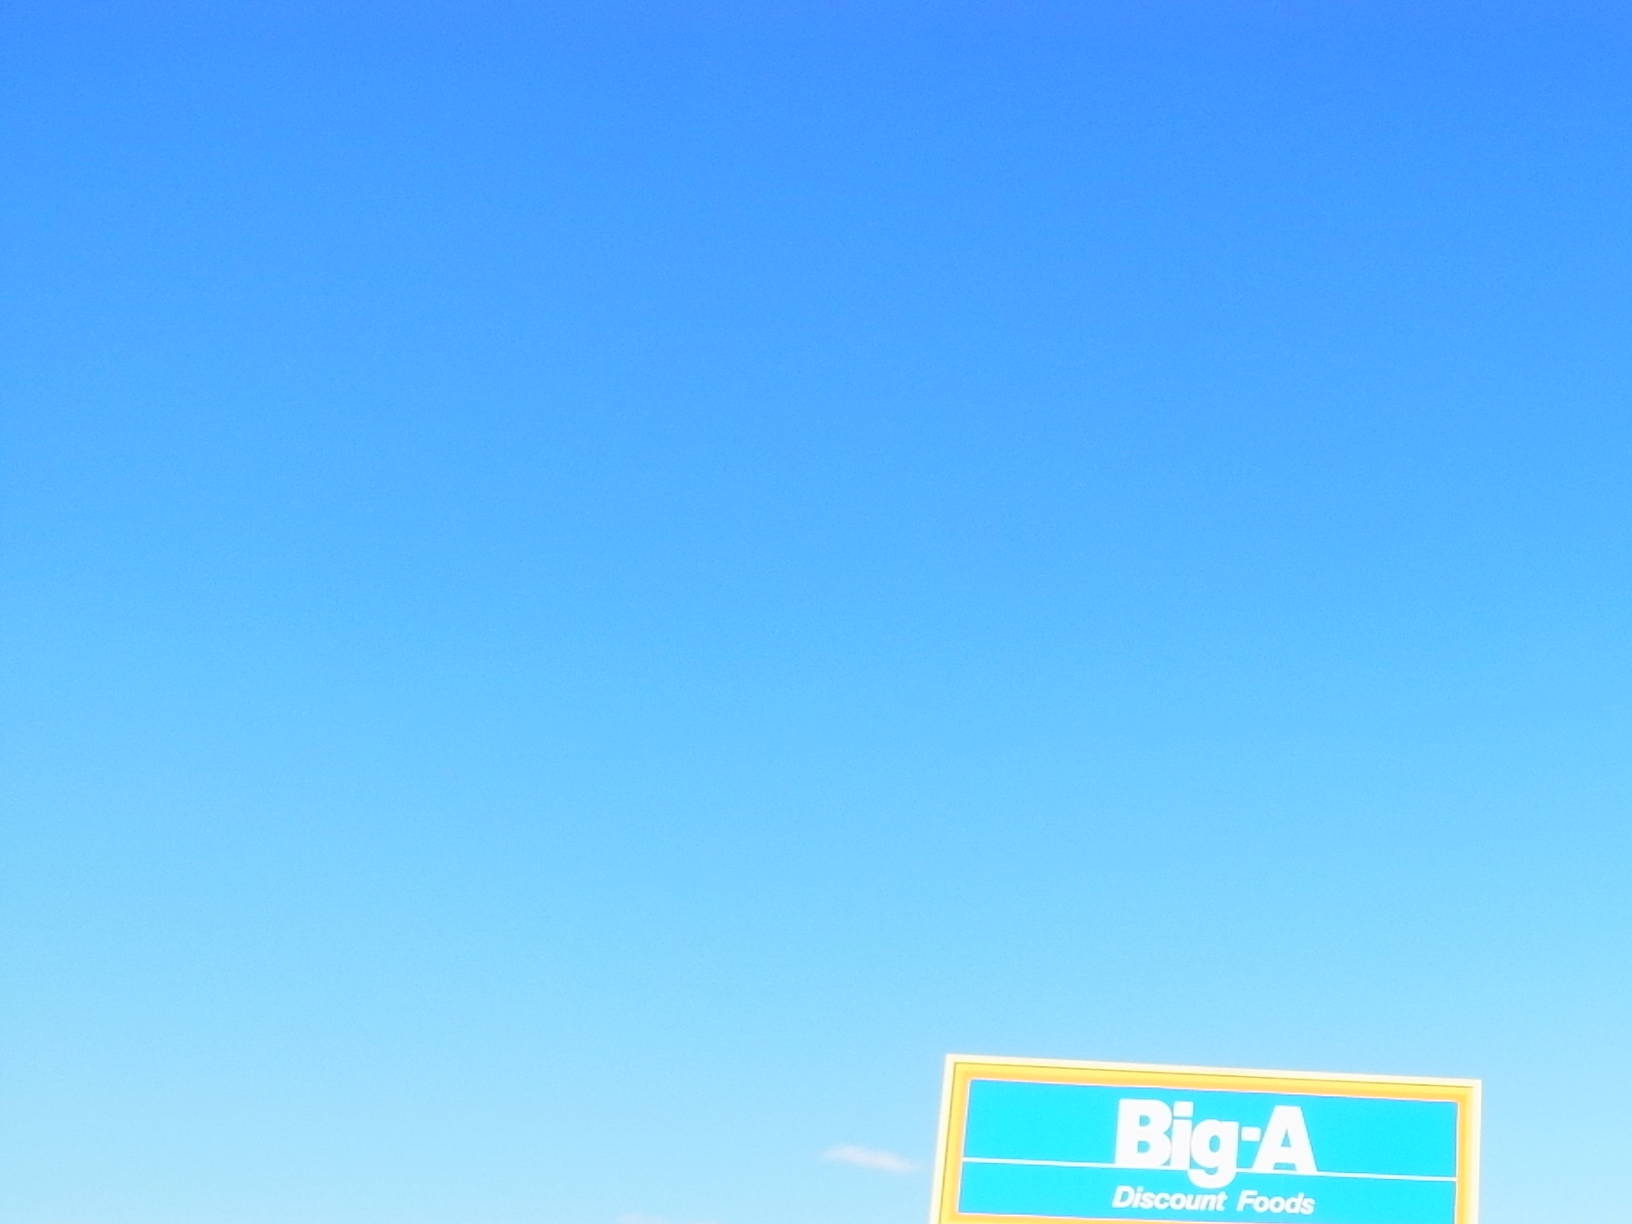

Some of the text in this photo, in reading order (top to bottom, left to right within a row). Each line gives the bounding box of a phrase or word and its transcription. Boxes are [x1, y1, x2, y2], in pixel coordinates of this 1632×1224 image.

[1113, 1098, 1317, 1188] Big-A
[1112, 1185, 1315, 1215] Discount Foods
